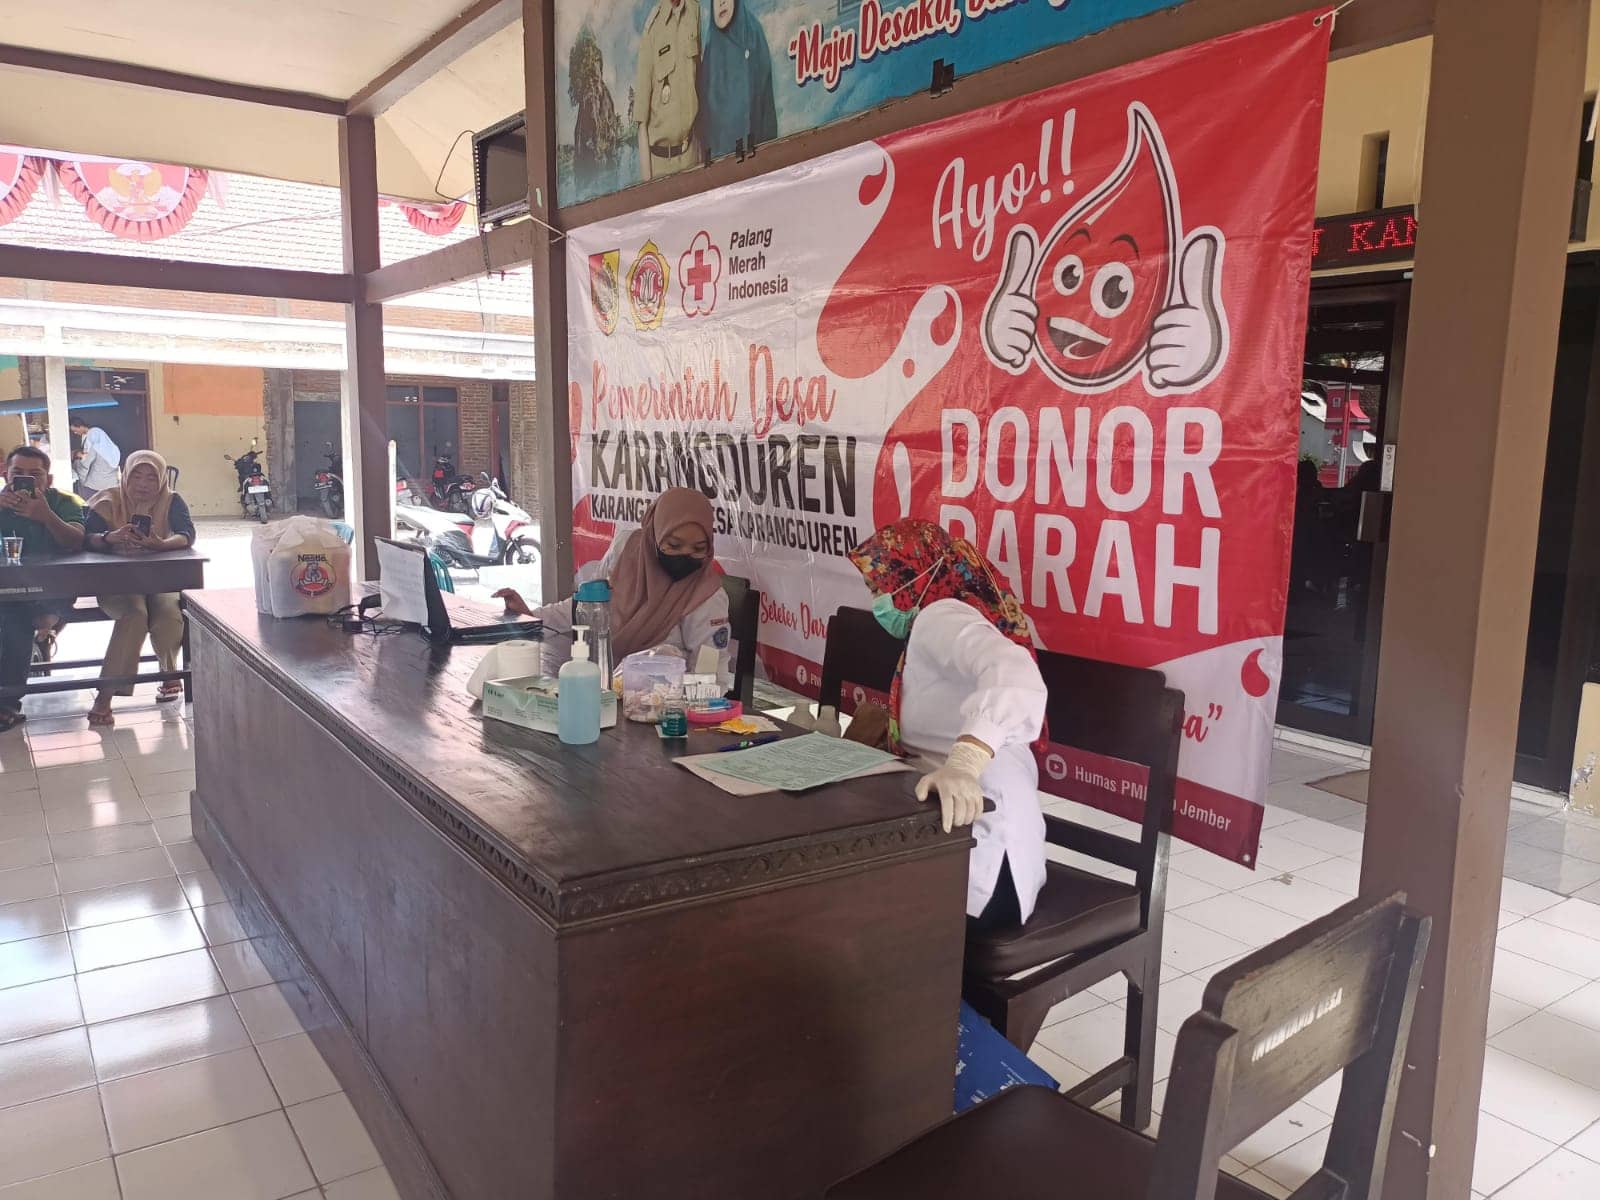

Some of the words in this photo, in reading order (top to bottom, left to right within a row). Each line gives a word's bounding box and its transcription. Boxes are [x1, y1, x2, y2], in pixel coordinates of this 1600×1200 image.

[932, 108, 1077, 262] Ayo!!
[729, 227, 773, 250] Palang
[728, 251, 766, 275] Merah
[727, 275, 789, 300] Indonesia
[591, 359, 738, 431] Pemerintah
[749, 343, 837, 440] Desa
[590, 429, 857, 517] KARANGDUREN
[940, 405, 1223, 519] DONOR
[591, 494, 652, 523] KARANG
[800, 602, 828, 640] Dar
[1075, 765, 1117, 793] Humas
[1120, 778, 1148, 801] PMI
[1180, 799, 1231, 832] Jember
